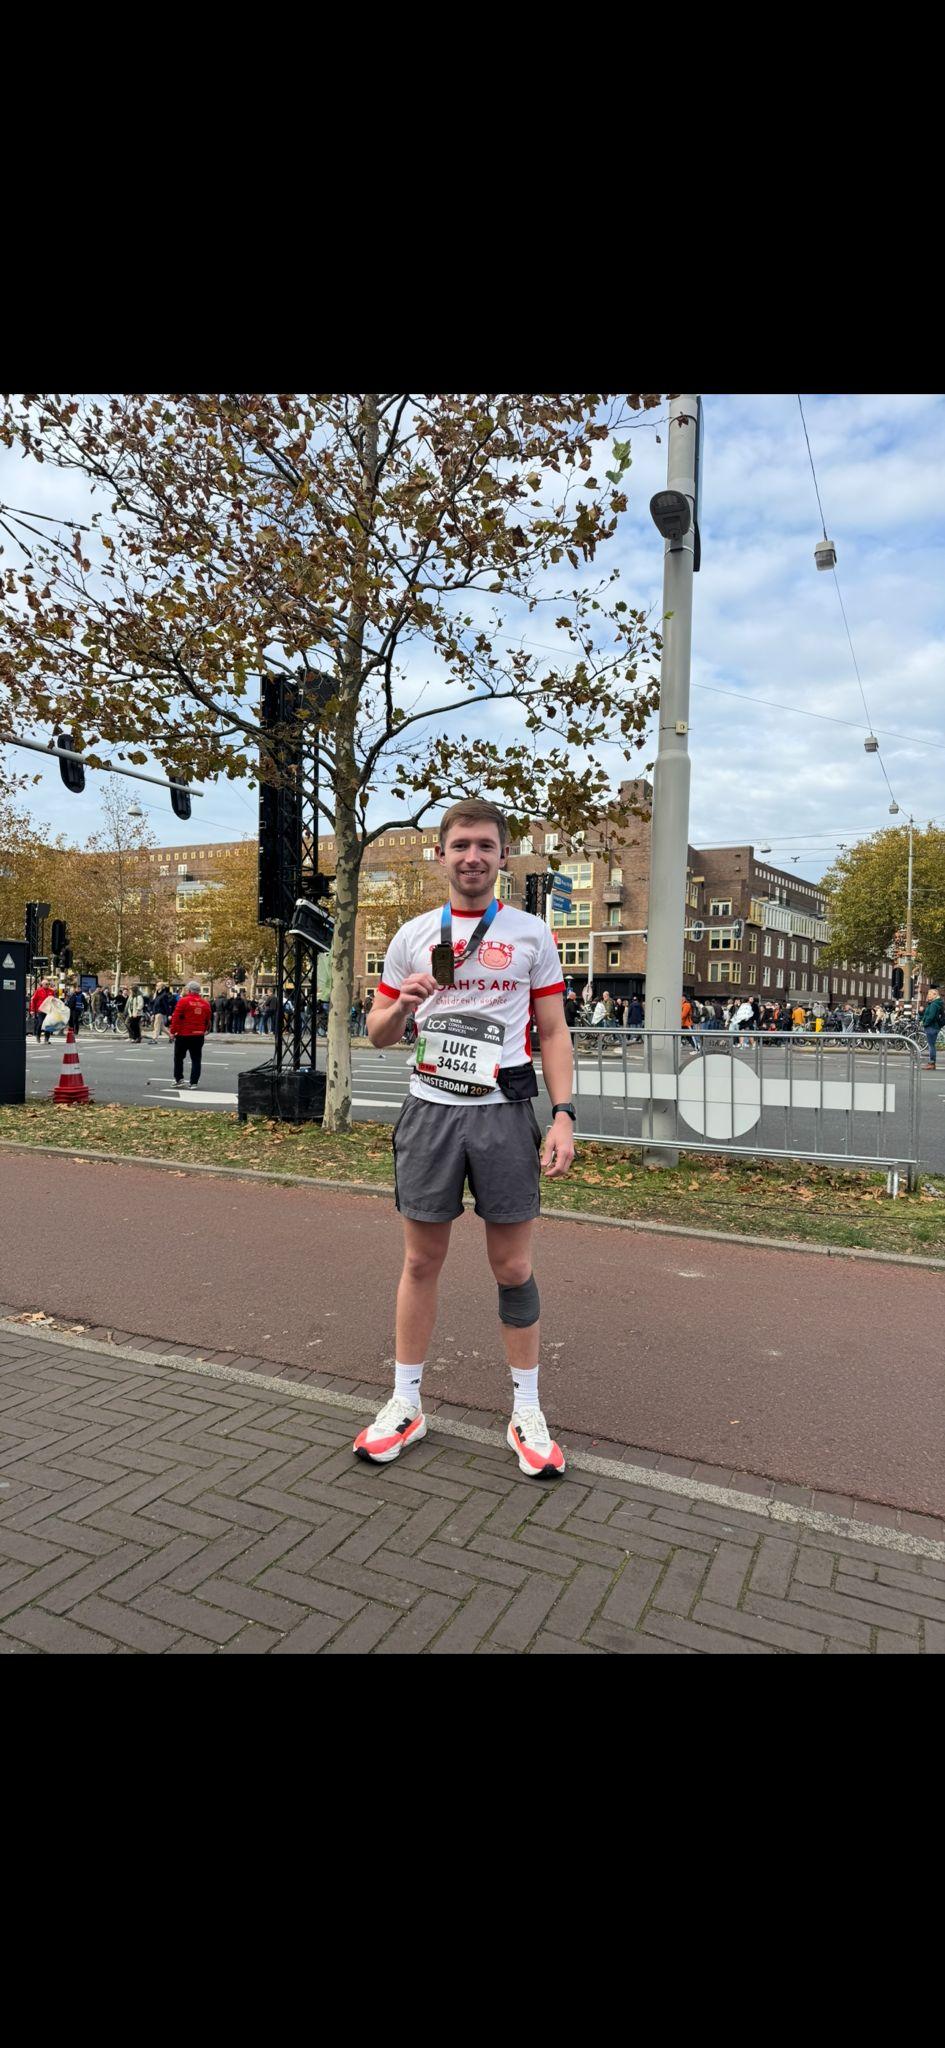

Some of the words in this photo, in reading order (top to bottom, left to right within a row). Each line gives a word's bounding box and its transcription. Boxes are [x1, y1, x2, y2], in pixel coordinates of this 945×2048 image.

[437, 980, 485, 992] AH'S
[490, 980, 519, 991] ARK
[427, 1018, 447, 1030] tcs
[448, 1022, 479, 1032] CONSULTANCY
[483, 1033, 500, 1042] TATA
[442, 1039, 478, 1059] LUKE
[436, 1056, 477, 1075] 34544
[419, 1074, 469, 1094] AMSTERDAM
